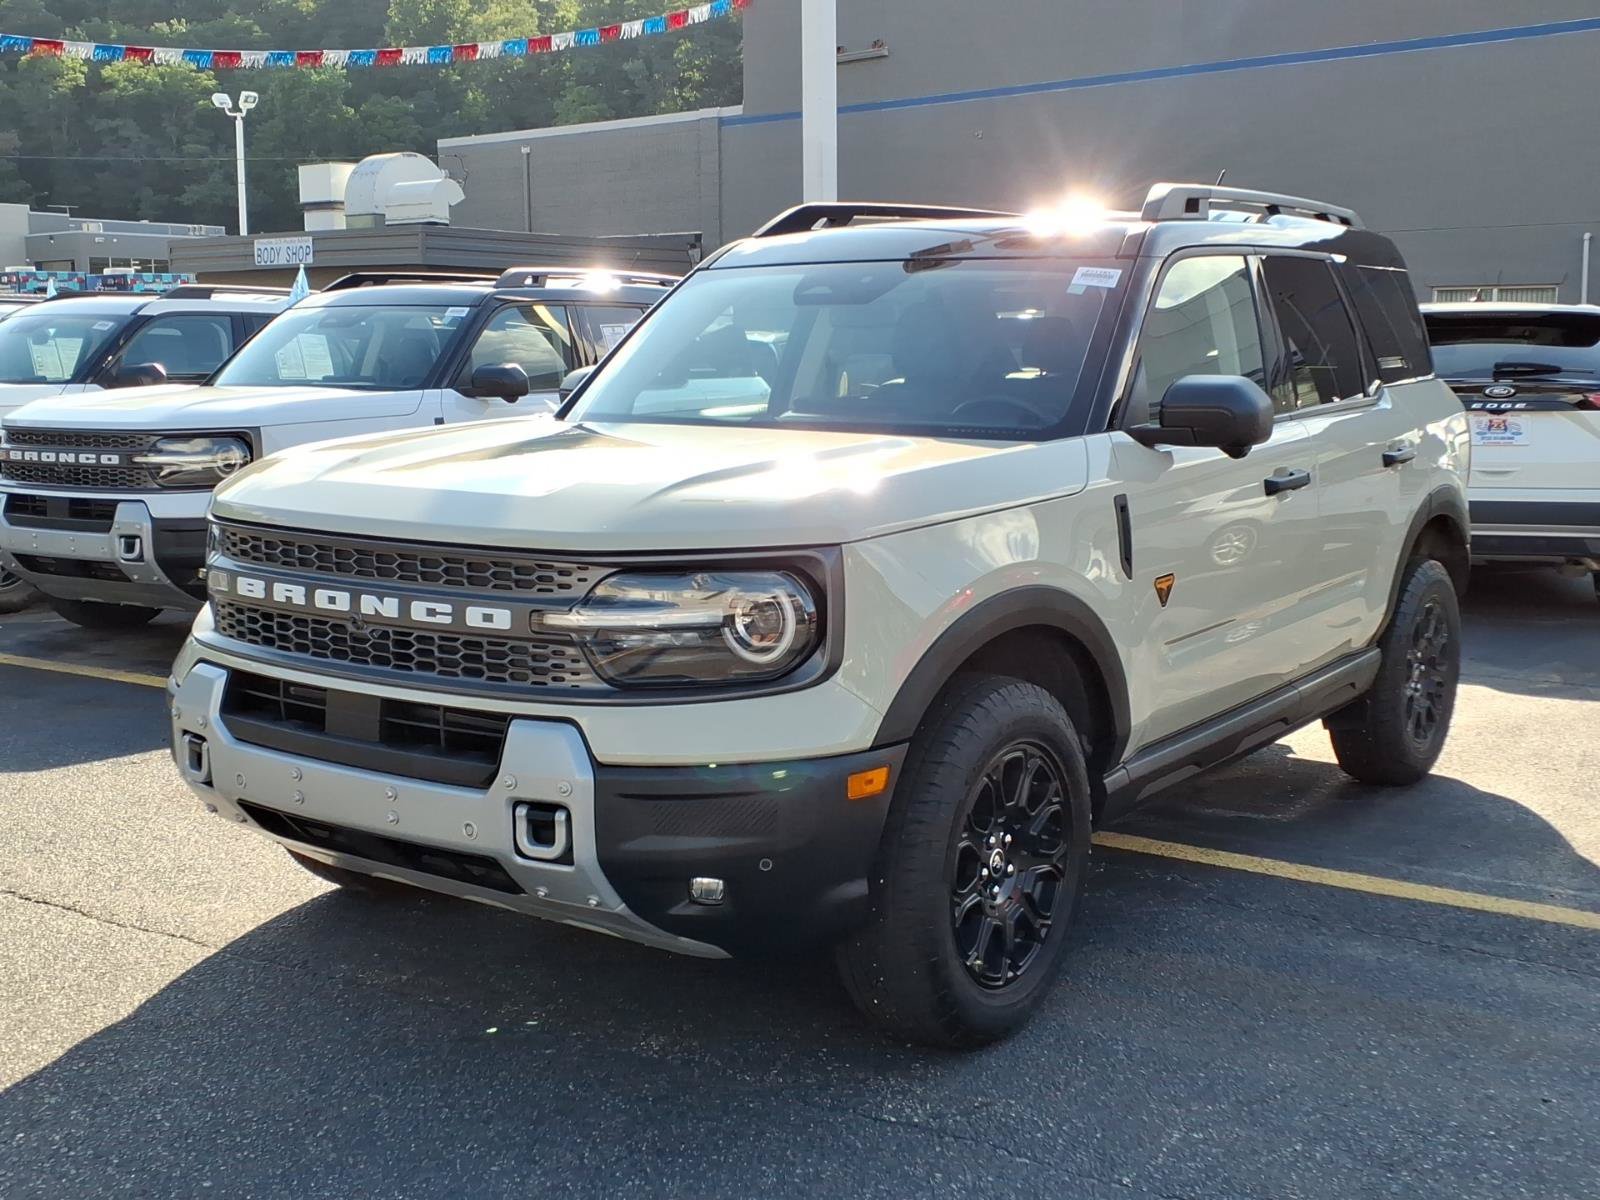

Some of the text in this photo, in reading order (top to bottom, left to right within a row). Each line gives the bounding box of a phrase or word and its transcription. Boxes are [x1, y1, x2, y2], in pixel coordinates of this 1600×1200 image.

[256, 245, 311, 264] BODY SHOP
[9, 450, 120, 464] BRONCO
[236, 576, 512, 630] BRONCO
